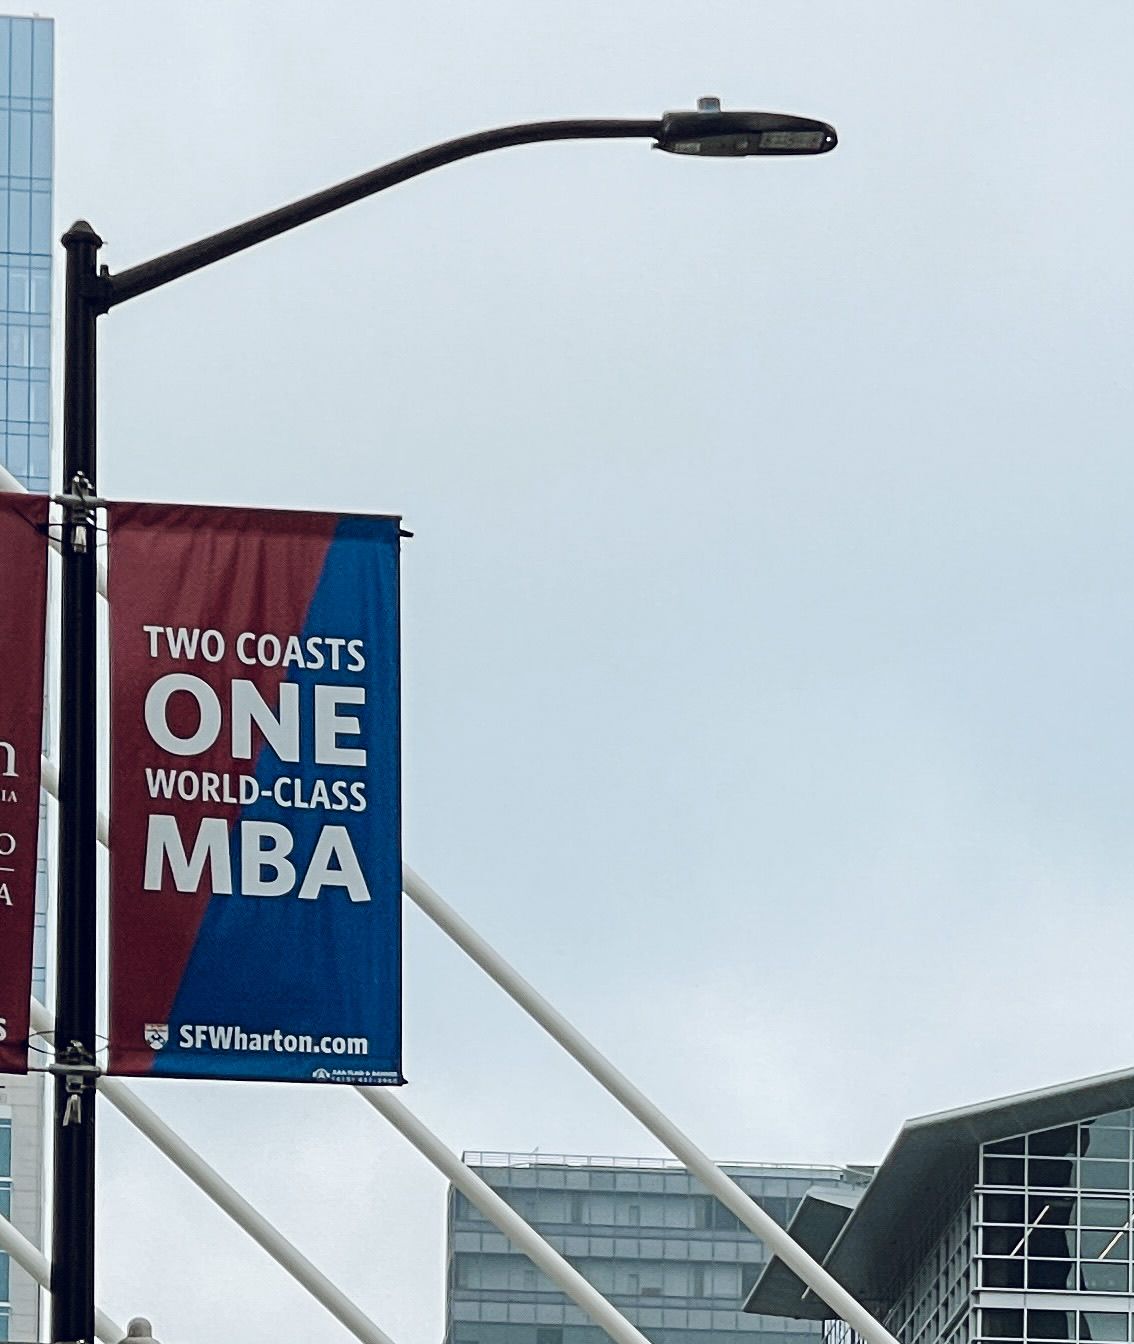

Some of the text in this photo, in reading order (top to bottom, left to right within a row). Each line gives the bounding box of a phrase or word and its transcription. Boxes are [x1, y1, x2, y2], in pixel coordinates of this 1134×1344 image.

[143, 625, 366, 672] TWO COASTS
[144, 673, 367, 767] ONE
[145, 768, 367, 812] WORLD-CLASS
[144, 814, 371, 903] MBA
[180, 1024, 368, 1056] SFWharton.com
